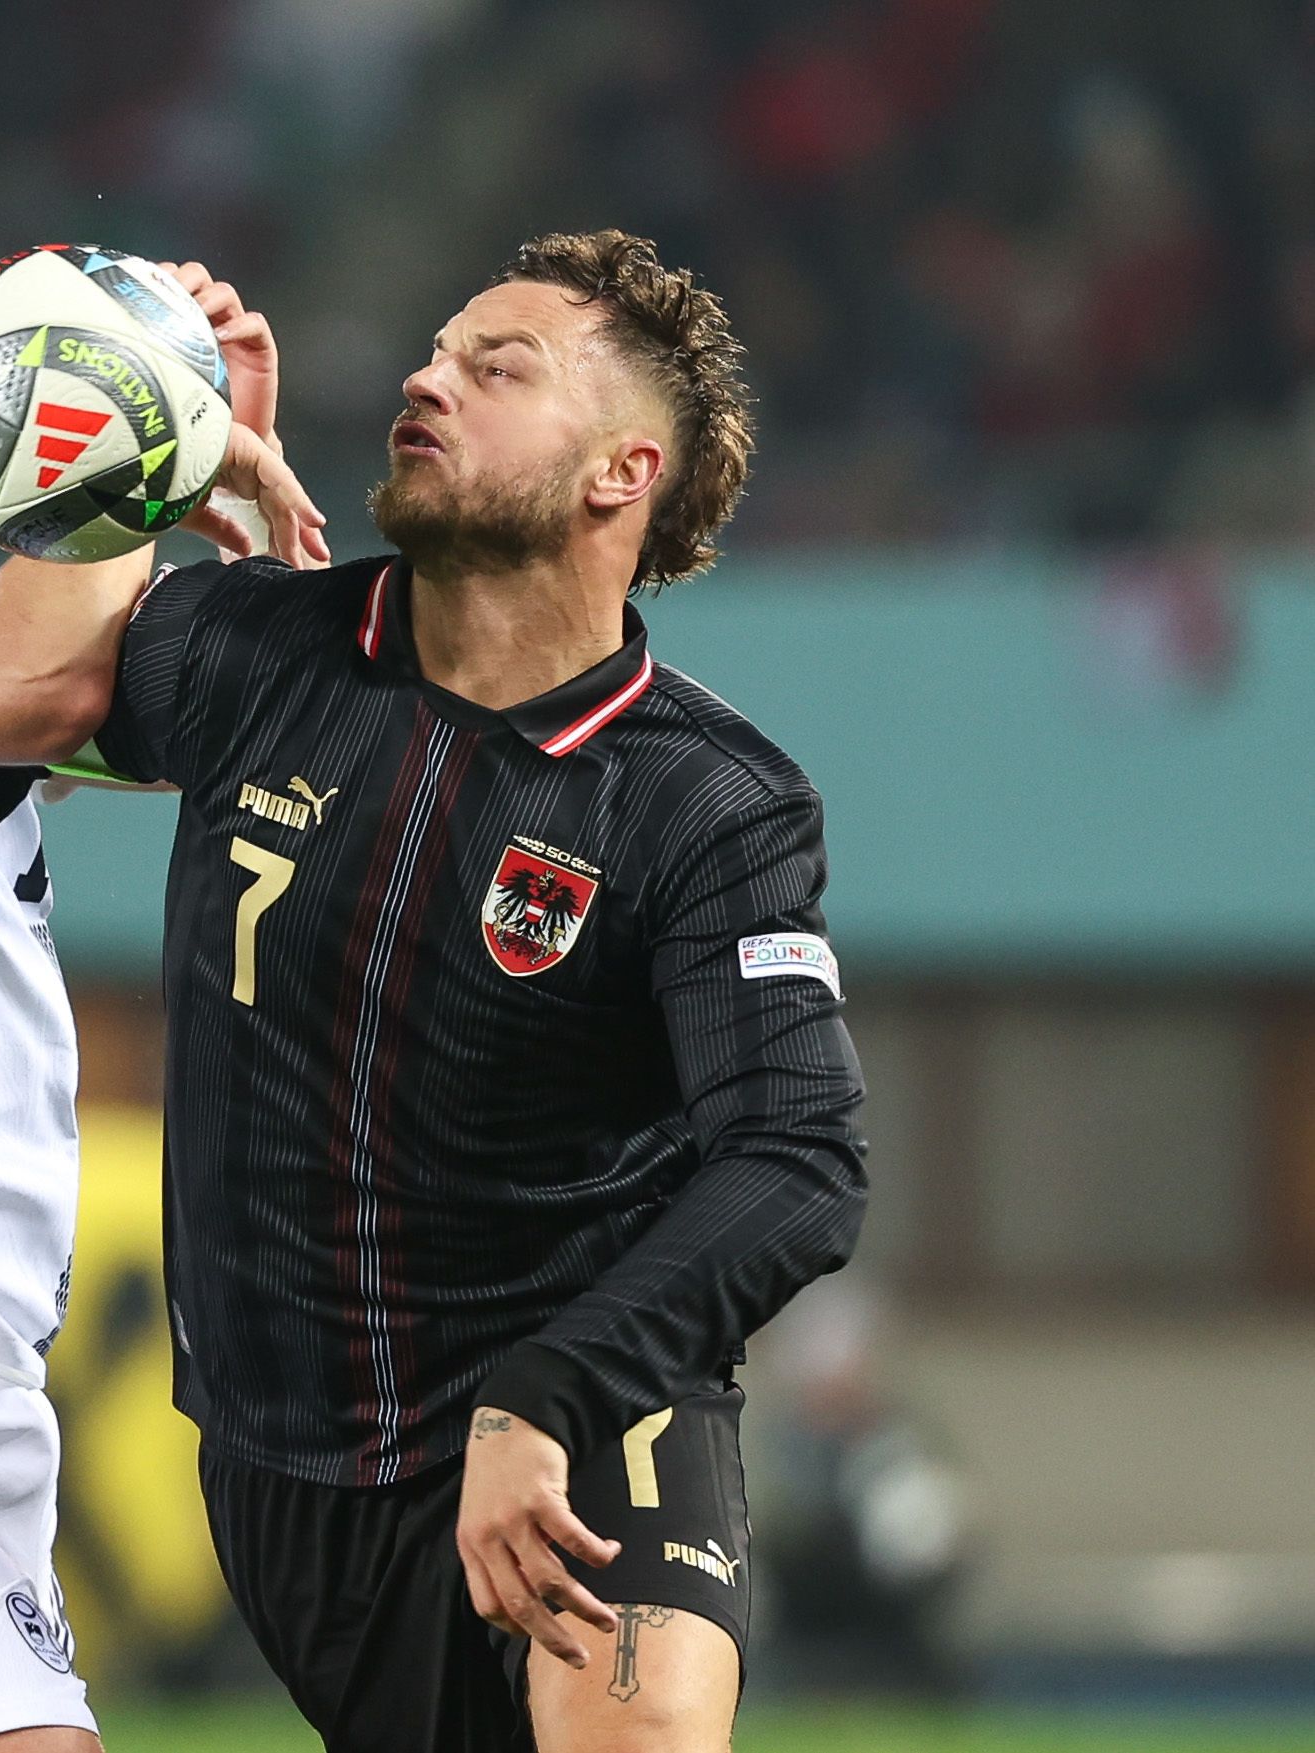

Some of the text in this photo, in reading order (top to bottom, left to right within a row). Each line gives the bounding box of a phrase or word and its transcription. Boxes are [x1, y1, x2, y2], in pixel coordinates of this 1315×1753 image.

[58, 338, 165, 430] NATIONS
[238, 782, 311, 831] PUMA
[545, 845, 571, 863] 50
[229, 835, 296, 1007] 7
[742, 937, 773, 949] UEFA
[743, 946, 837, 978] FOUNDA
[663, 1541, 729, 1586] PUMA
